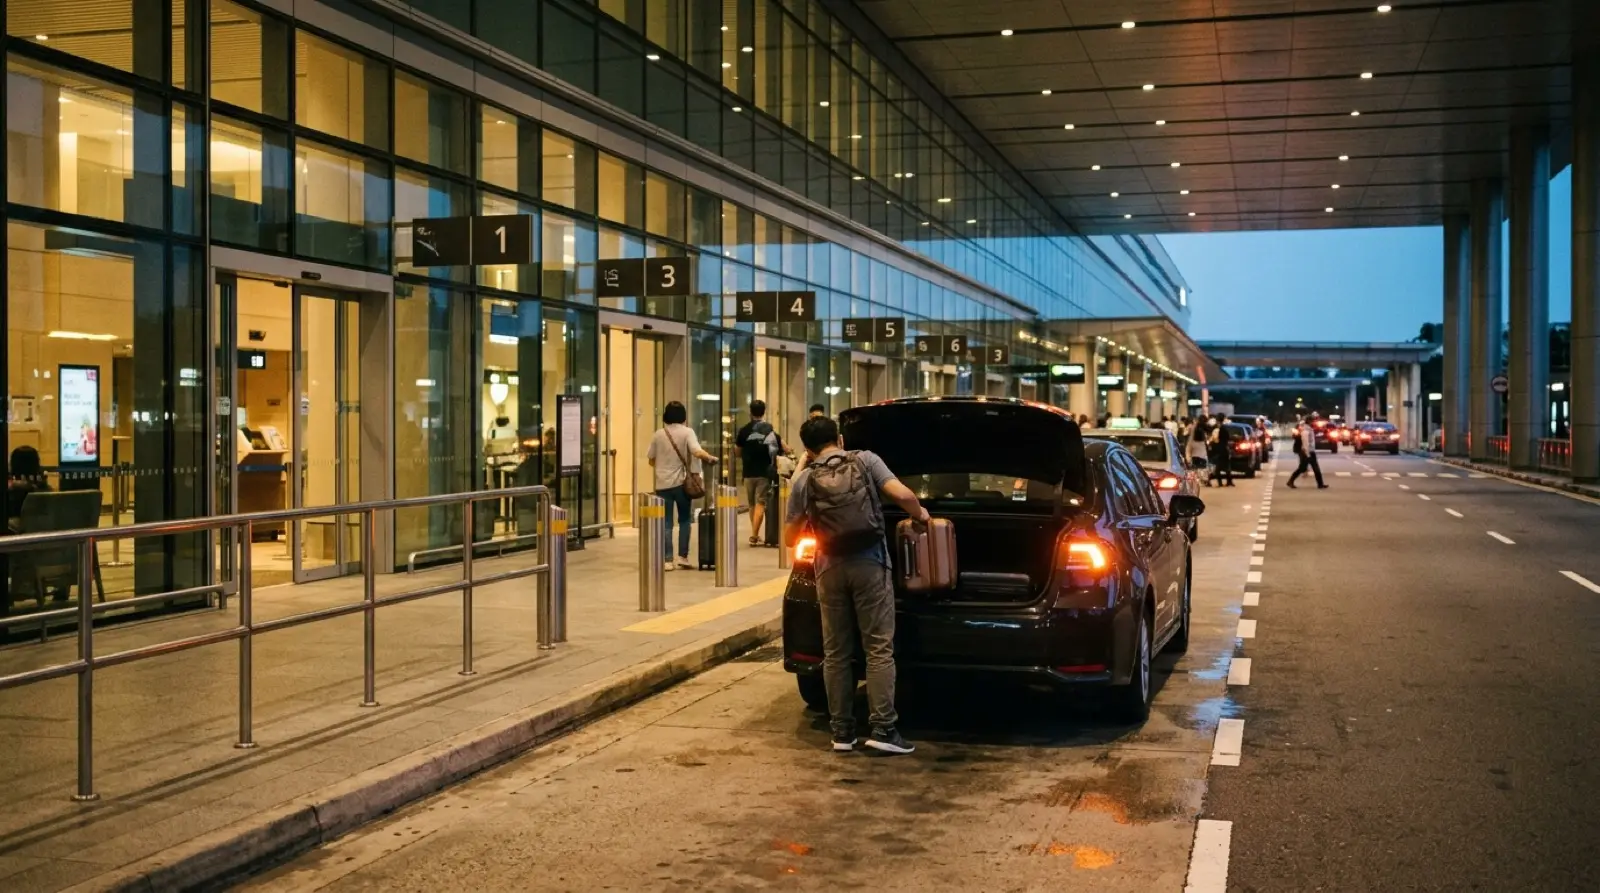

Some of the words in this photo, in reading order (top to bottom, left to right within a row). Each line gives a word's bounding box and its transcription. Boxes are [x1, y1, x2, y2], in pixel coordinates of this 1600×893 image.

[494, 225, 507, 255] 1
[660, 264, 677, 288] 3
[789, 297, 805, 317] 4
[885, 321, 896, 338] 5
[950, 338, 960, 353] 6
[994, 349, 1003, 362] 3
